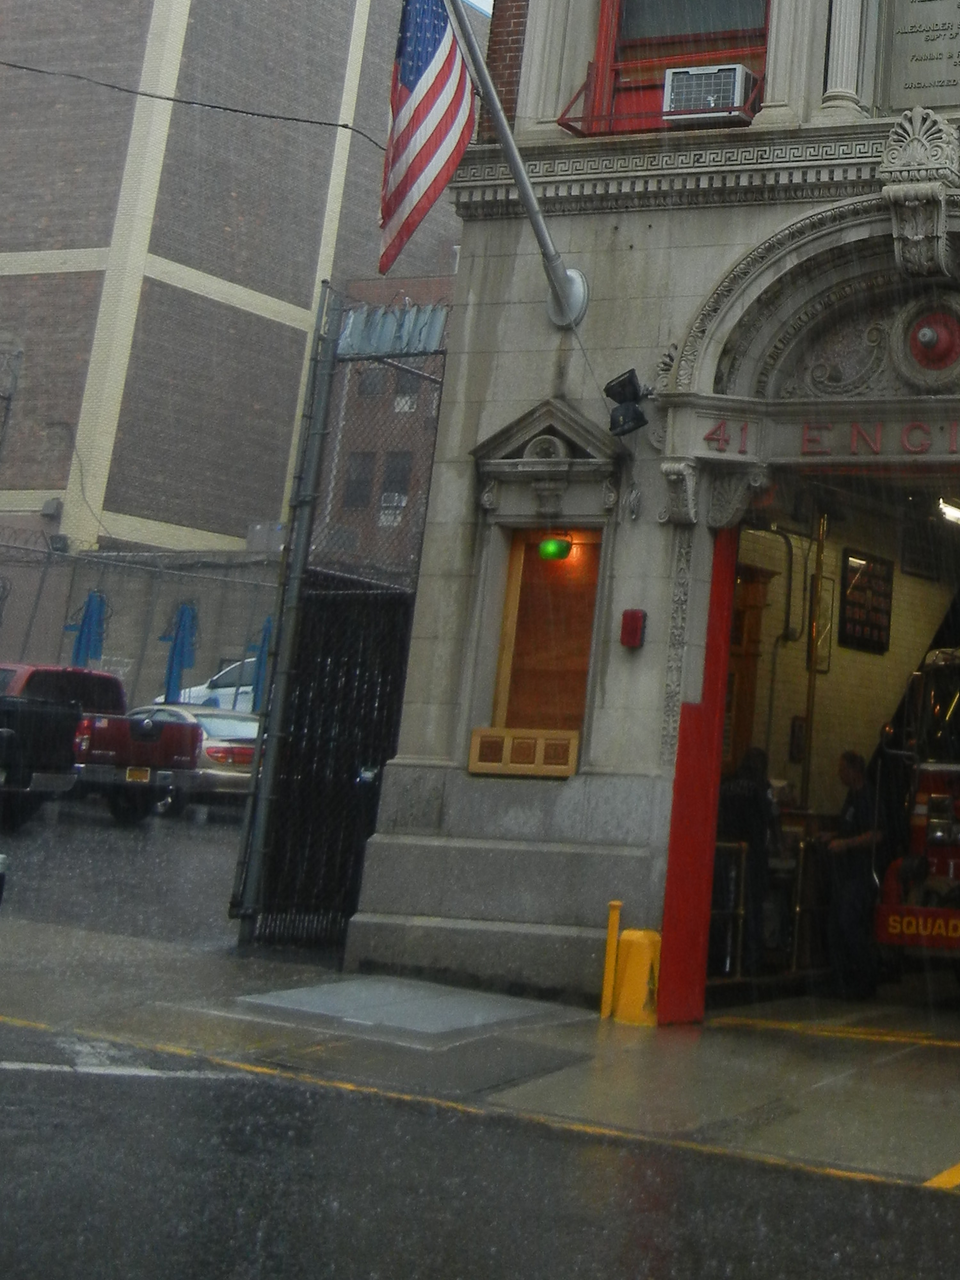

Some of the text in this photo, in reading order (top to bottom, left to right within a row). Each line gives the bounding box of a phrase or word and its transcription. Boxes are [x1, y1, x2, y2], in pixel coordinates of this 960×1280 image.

[896, 22, 953, 35] ALEXANDER
[949, 32, 960, 40] OF
[703, 419, 749, 454] 41
